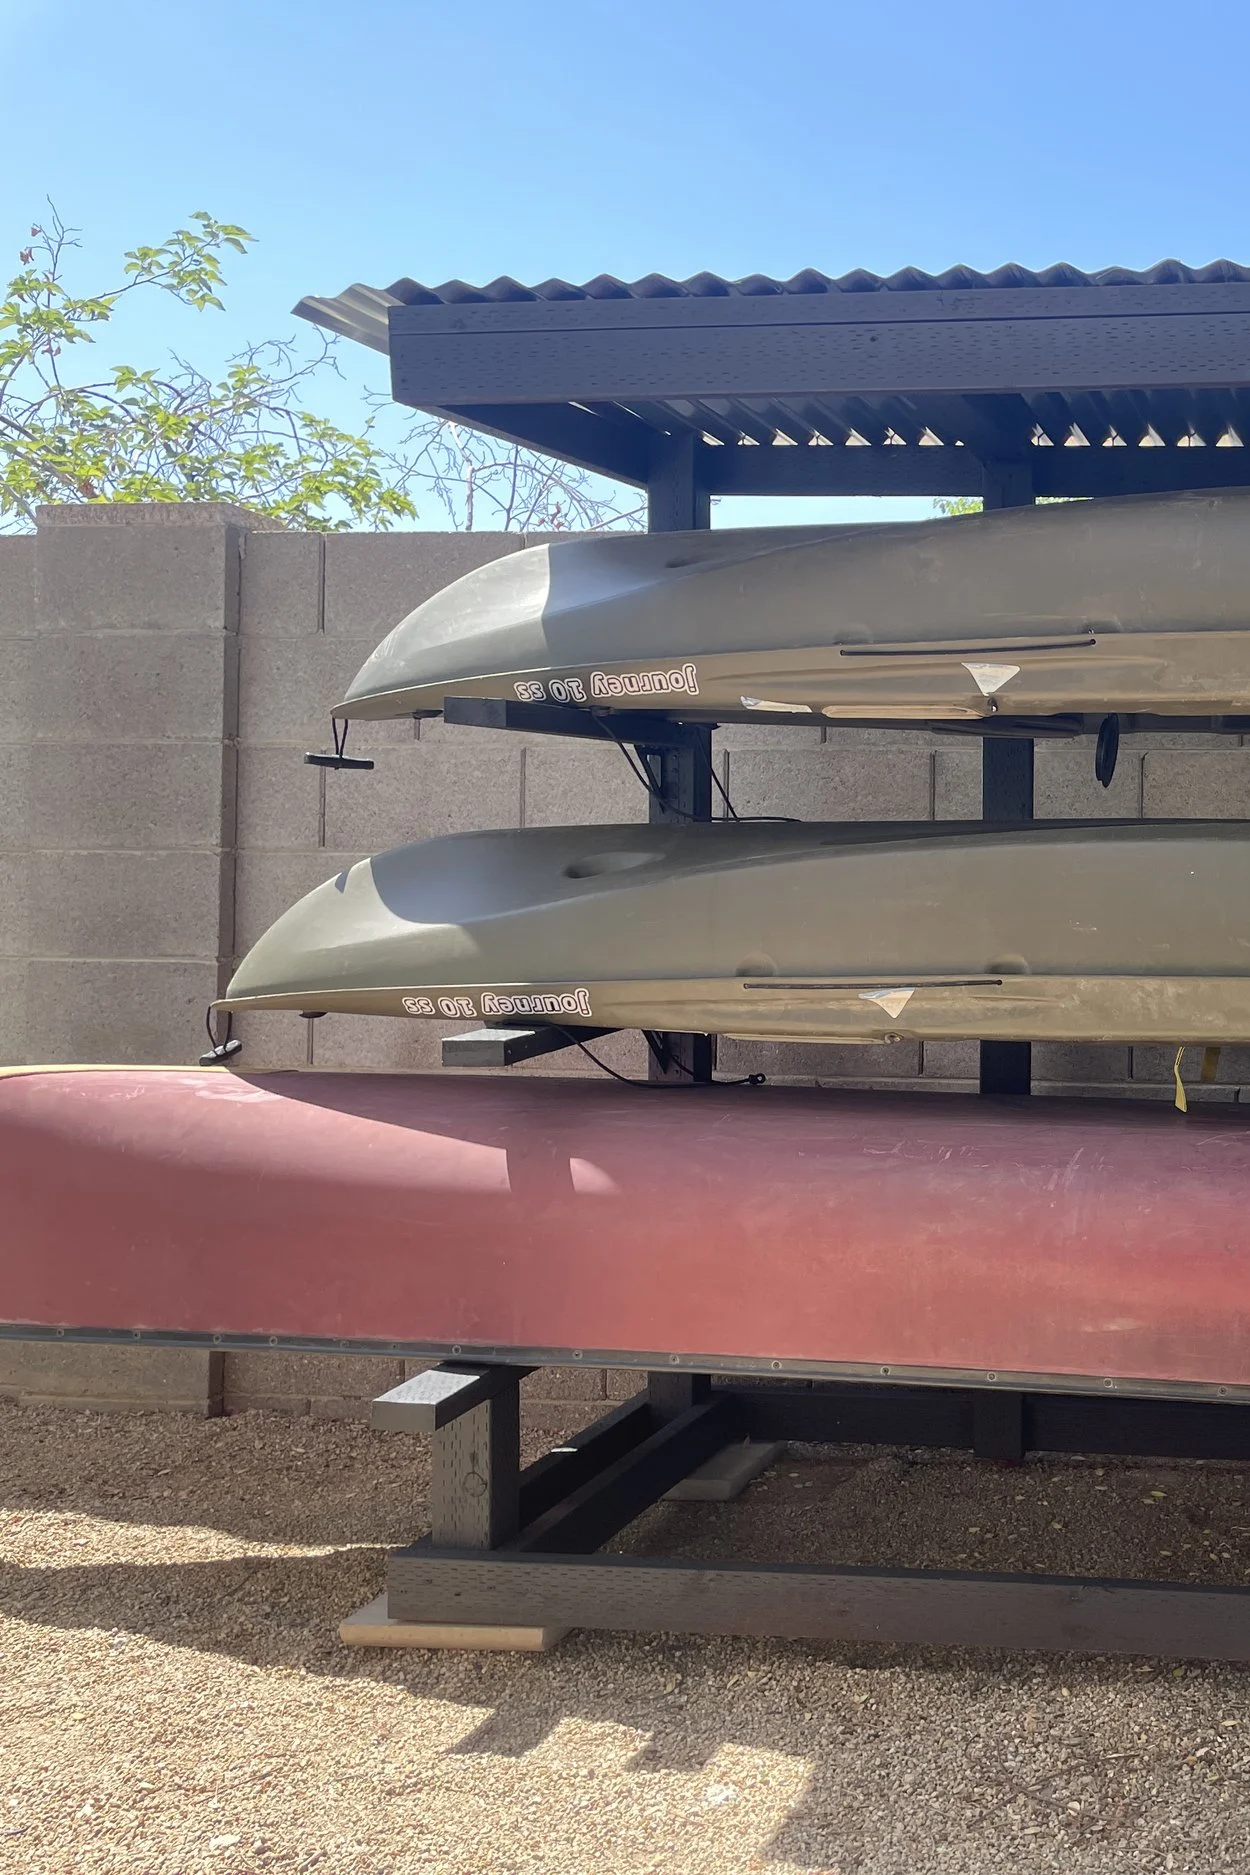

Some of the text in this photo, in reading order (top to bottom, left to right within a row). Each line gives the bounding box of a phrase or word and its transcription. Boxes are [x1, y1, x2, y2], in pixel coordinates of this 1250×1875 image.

[514, 663, 699, 702] journey 10 ss
[402, 988, 592, 1018] journey 10 ss
